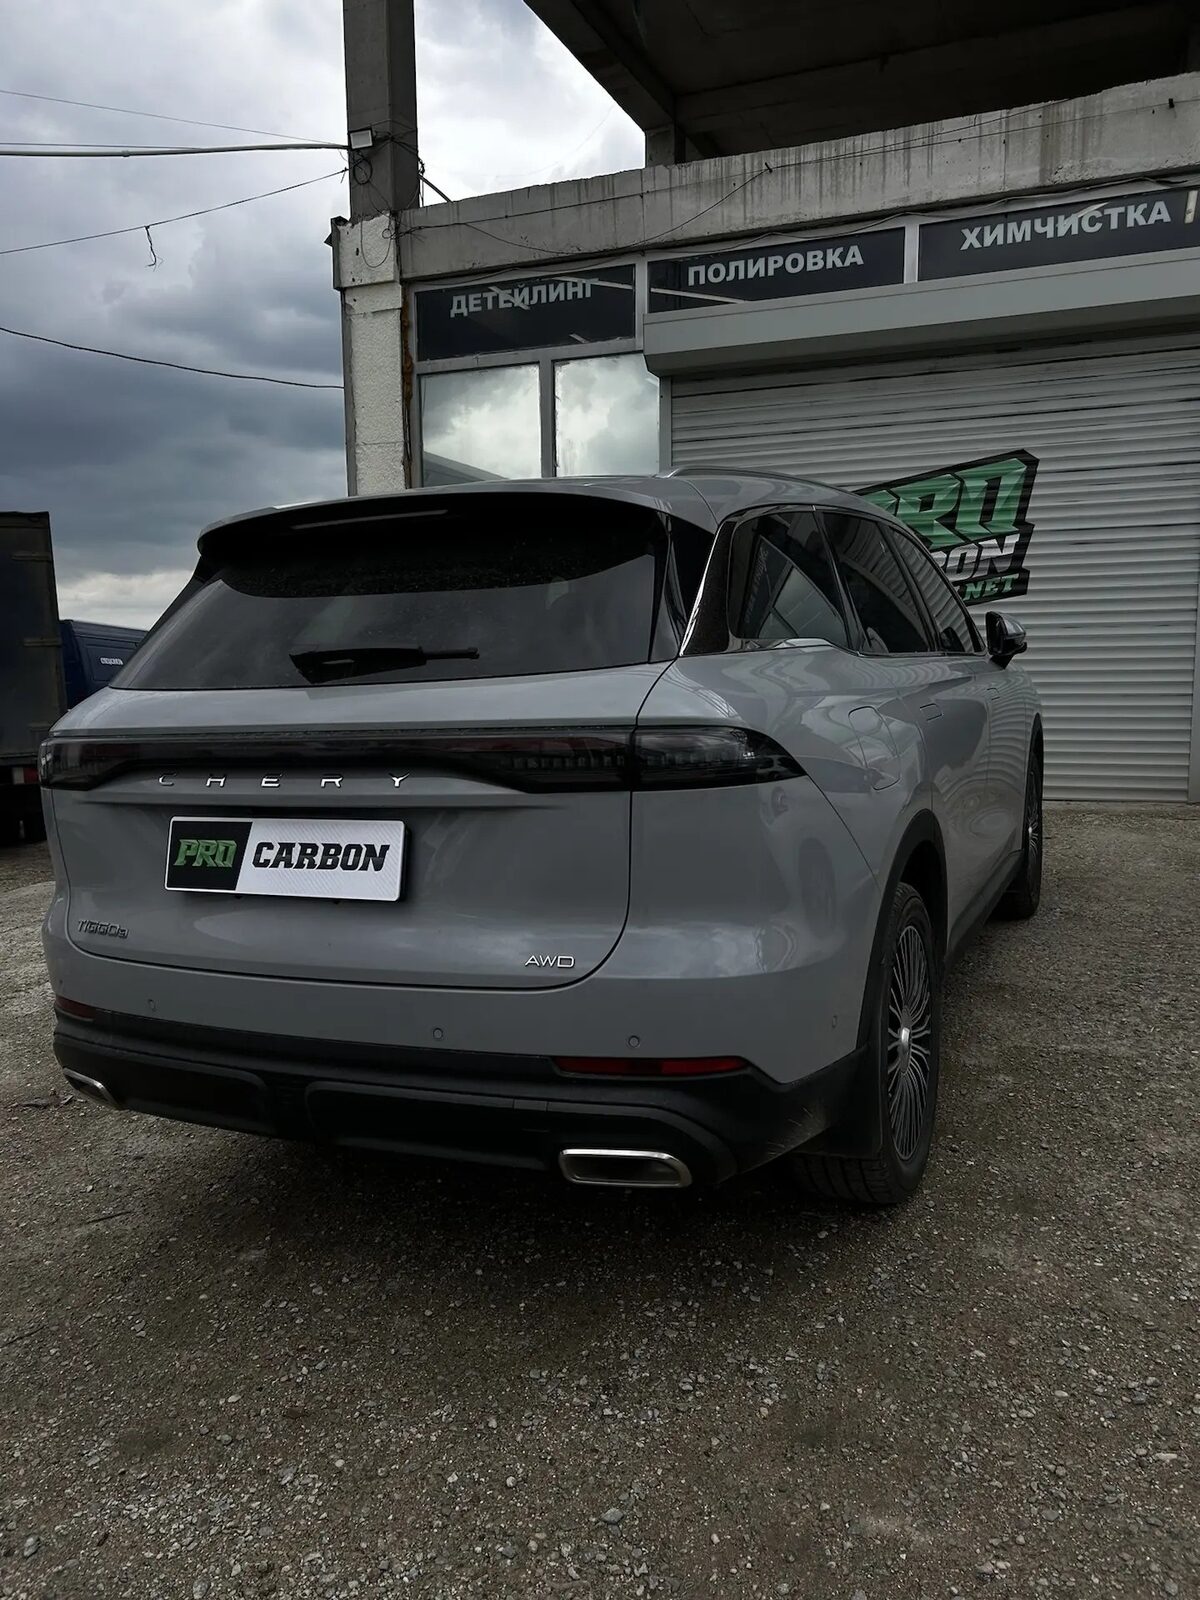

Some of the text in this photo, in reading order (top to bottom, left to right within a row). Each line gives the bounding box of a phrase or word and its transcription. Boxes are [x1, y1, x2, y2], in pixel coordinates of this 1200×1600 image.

[960, 201, 1171, 250] ХИМЧИСТКА
[687, 245, 865, 287] ПОЛИРОВКА
[450, 278, 599, 318] ДЕТЕЙЛИНГ
[158, 773, 410, 788] CHERY
[173, 839, 390, 872] PRO CARBON
[525, 955, 575, 968] AWD
